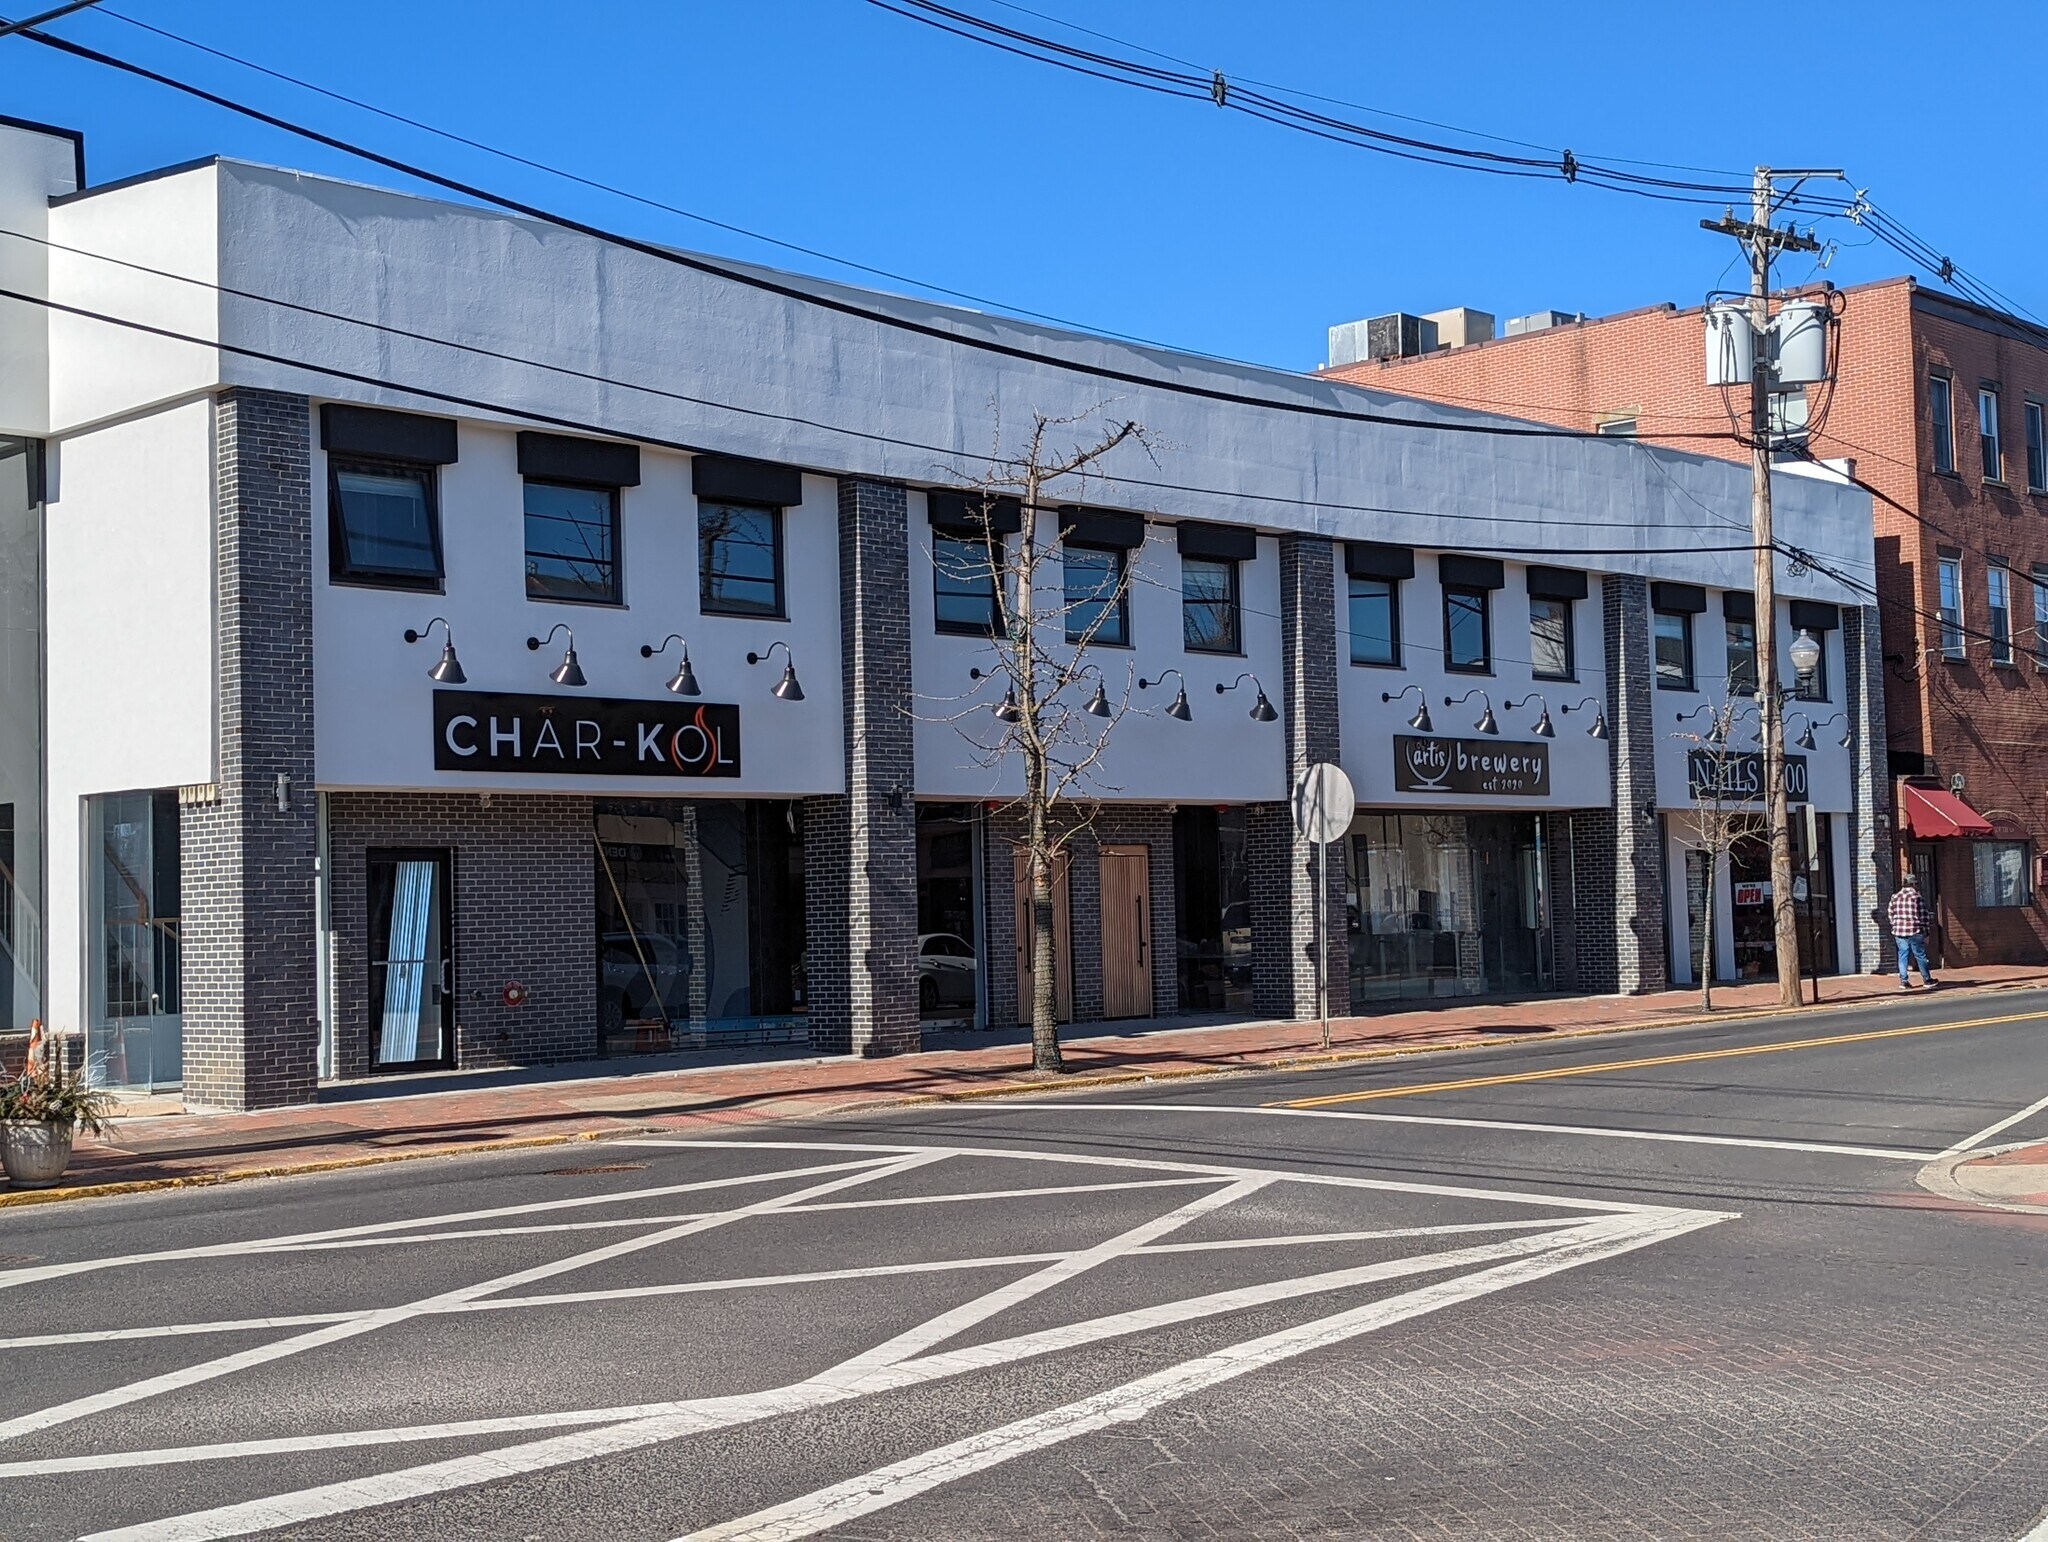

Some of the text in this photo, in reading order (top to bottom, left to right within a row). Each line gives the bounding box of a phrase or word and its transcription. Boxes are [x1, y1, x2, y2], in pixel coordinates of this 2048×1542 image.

[1413, 741, 1542, 785] artis brewery
[1694, 758, 1759, 792] NAILS
[1482, 775, 1498, 791] est
[1737, 888, 1761, 903] OPEN
